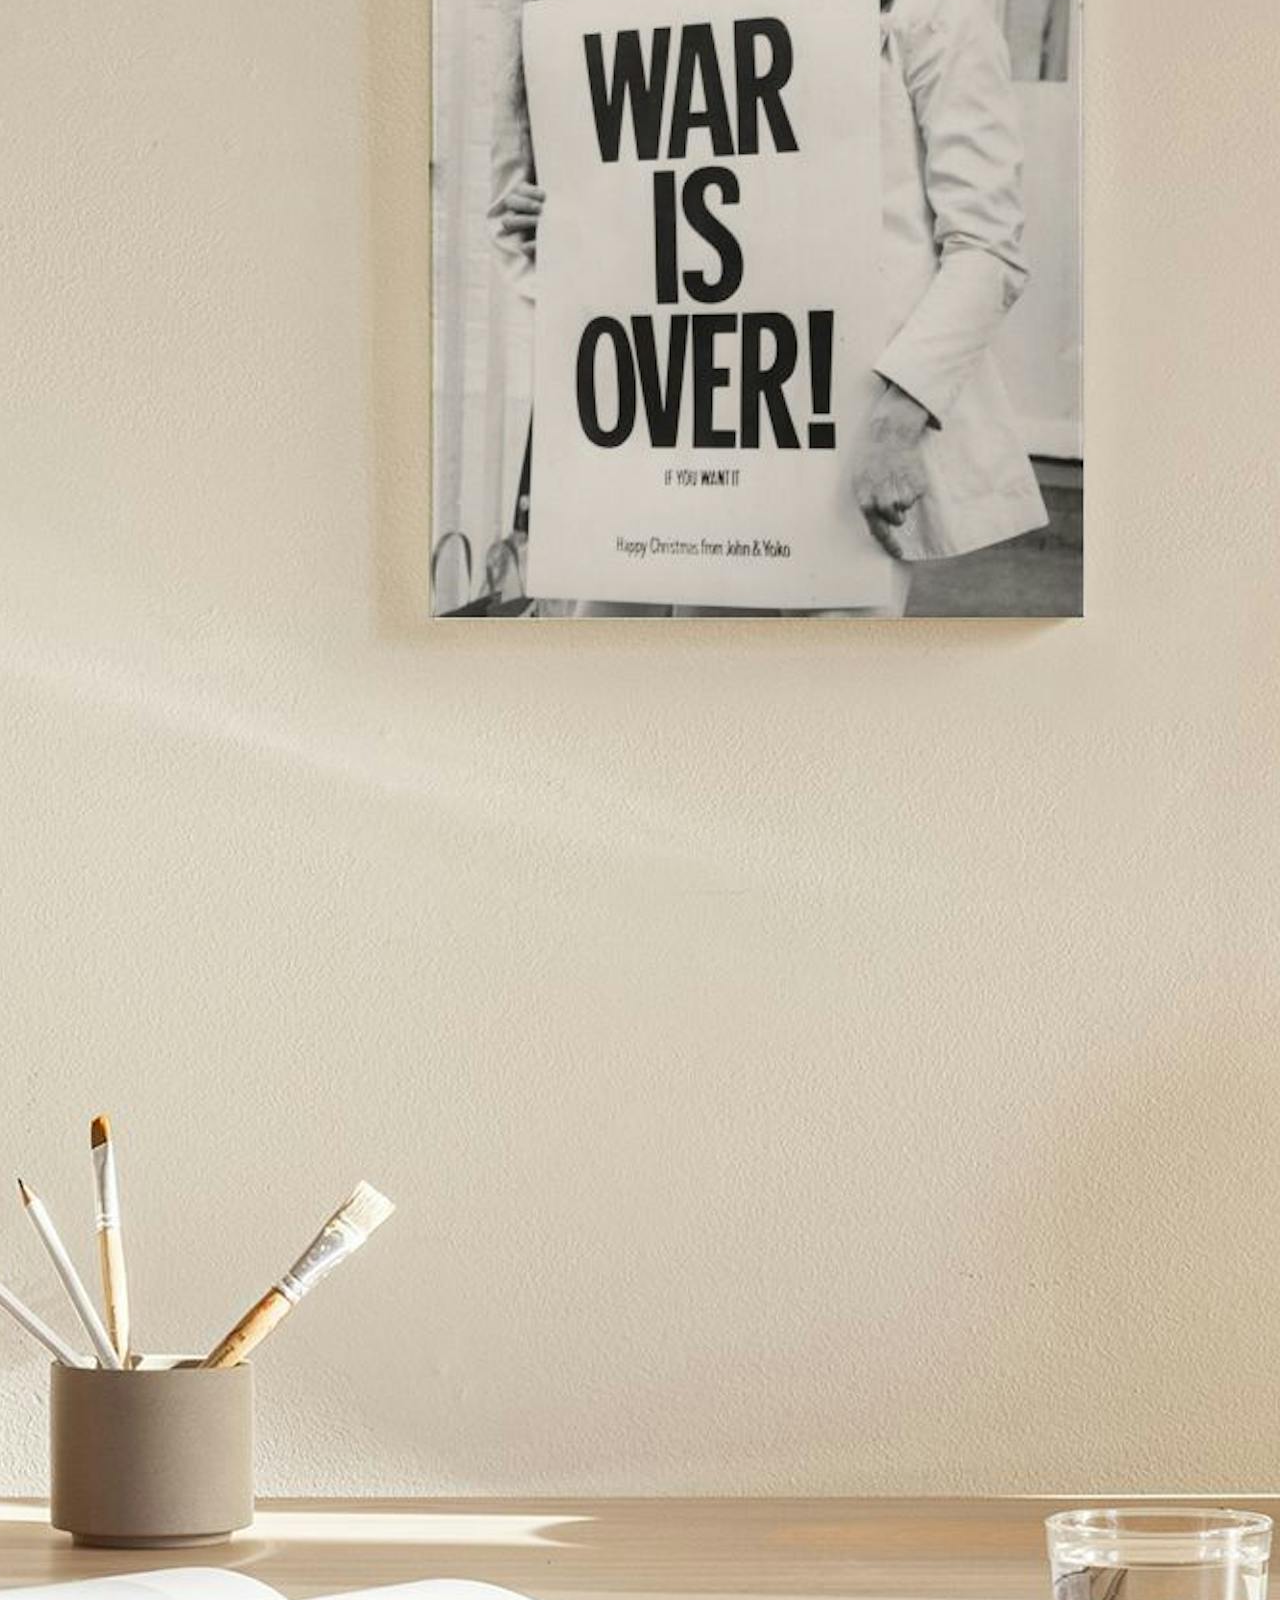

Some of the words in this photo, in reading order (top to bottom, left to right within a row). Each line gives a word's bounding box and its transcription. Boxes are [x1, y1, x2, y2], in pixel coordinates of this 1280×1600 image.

[583, 17, 800, 163] WAR
[653, 166, 744, 305] IS
[576, 310, 836, 449] OVER!
[616, 536, 647, 559] Happy
[649, 536, 699, 556] Christmas
[701, 538, 723, 556] from
[726, 540, 751, 557] John
[752, 540, 762, 557] &
[762, 540, 792, 558] Yoko
[664, 469, 673, 486] IF
[676, 469, 698, 487] YOU
[701, 469, 730, 486] WANT
[731, 469, 741, 486] IT
